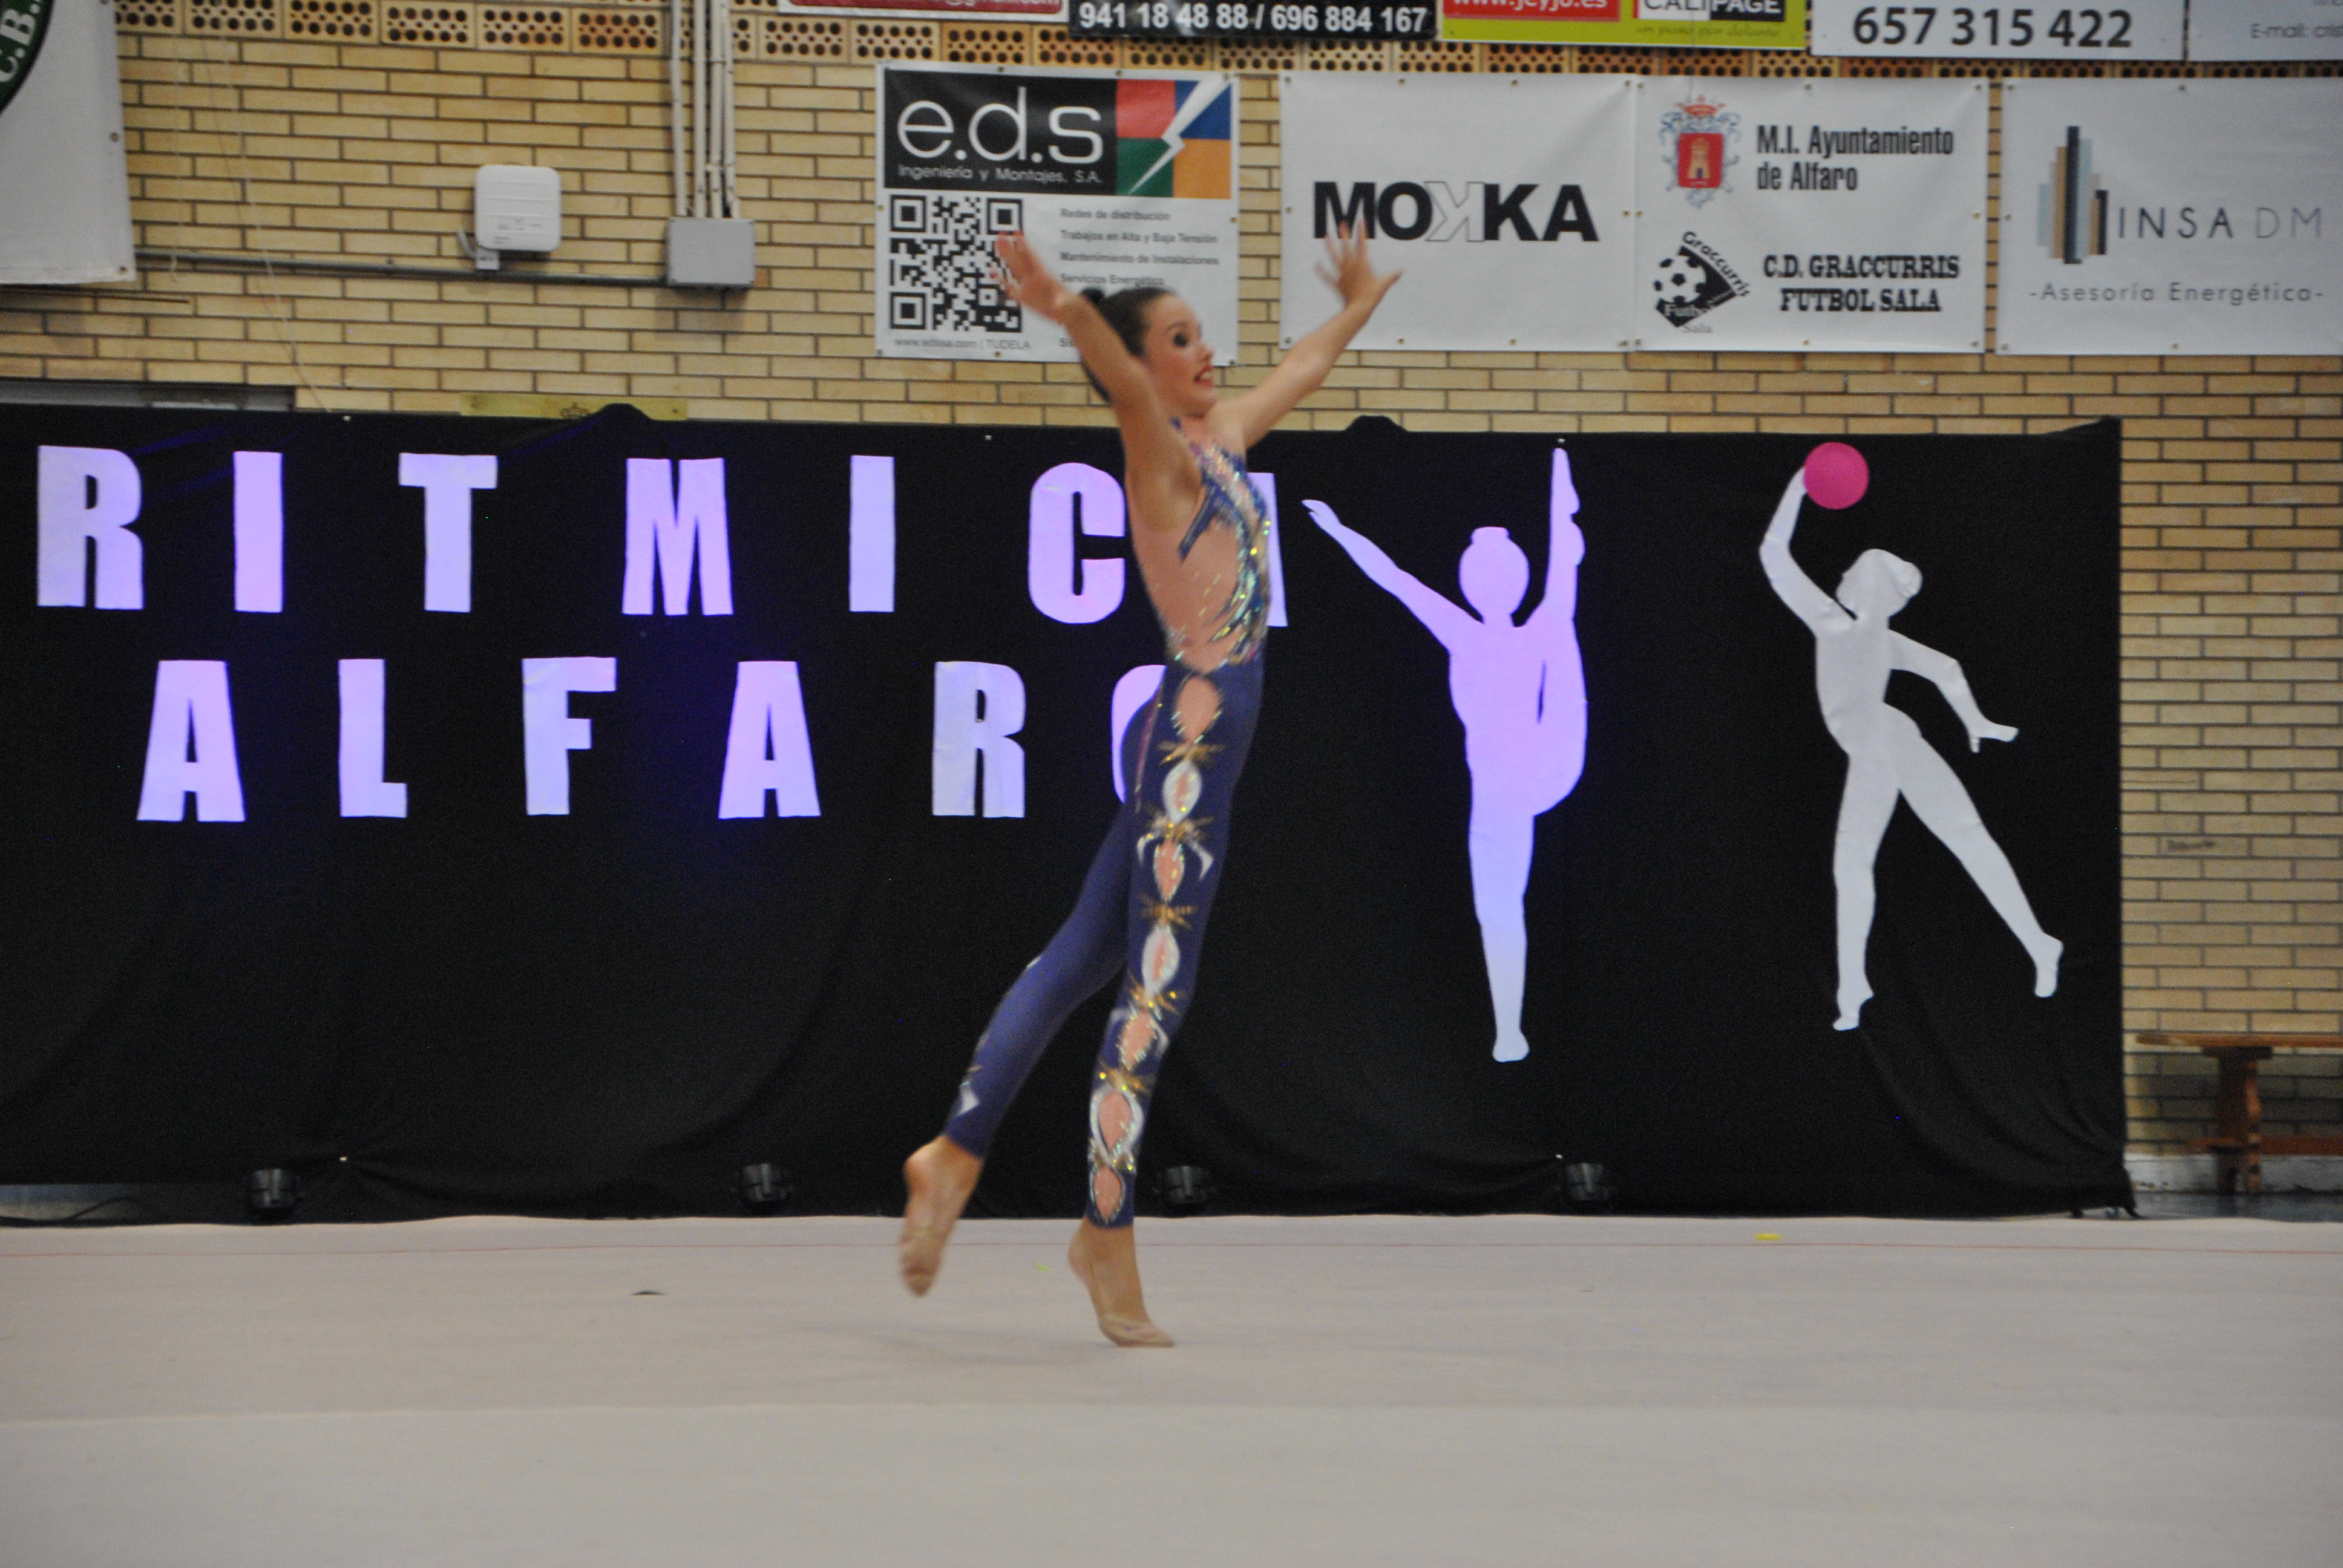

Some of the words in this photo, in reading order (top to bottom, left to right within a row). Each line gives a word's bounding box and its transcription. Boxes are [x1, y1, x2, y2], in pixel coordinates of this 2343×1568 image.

[1079, 2, 1127, 28] 941
[1138, 2, 1168, 28] 18
[1176, 3, 1209, 28] 48
[1216, 4, 1248, 30] 88
[1271, 5, 1318, 31] 696
[1325, 6, 1372, 31] 884
[1381, 7, 1427, 33] 167
[1852, 7, 1936, 45] 657
[1951, 8, 2034, 46] 315
[2048, 9, 2132, 48] 422
[897, 87, 1104, 164] e.d.s
[1757, 125, 1799, 154] M.I.
[1808, 126, 1954, 158] Ayuntamiento
[980, 169, 990, 181] y
[1757, 162, 1781, 190] de
[1789, 163, 1858, 191] Alfaro
[1096, 209, 1107, 219] de
[1313, 181, 1600, 242] MOKKA
[2117, 206, 2234, 239] INSA
[2255, 206, 2323, 239] DM
[1137, 253, 1150, 263] de
[1763, 254, 1804, 278] C.D.
[1809, 255, 1959, 279] GRACCURRIS
[1780, 288, 1875, 312] FUTBOL
[1880, 289, 1941, 313] SALA
[38, 445, 1288, 627] RITMIC
